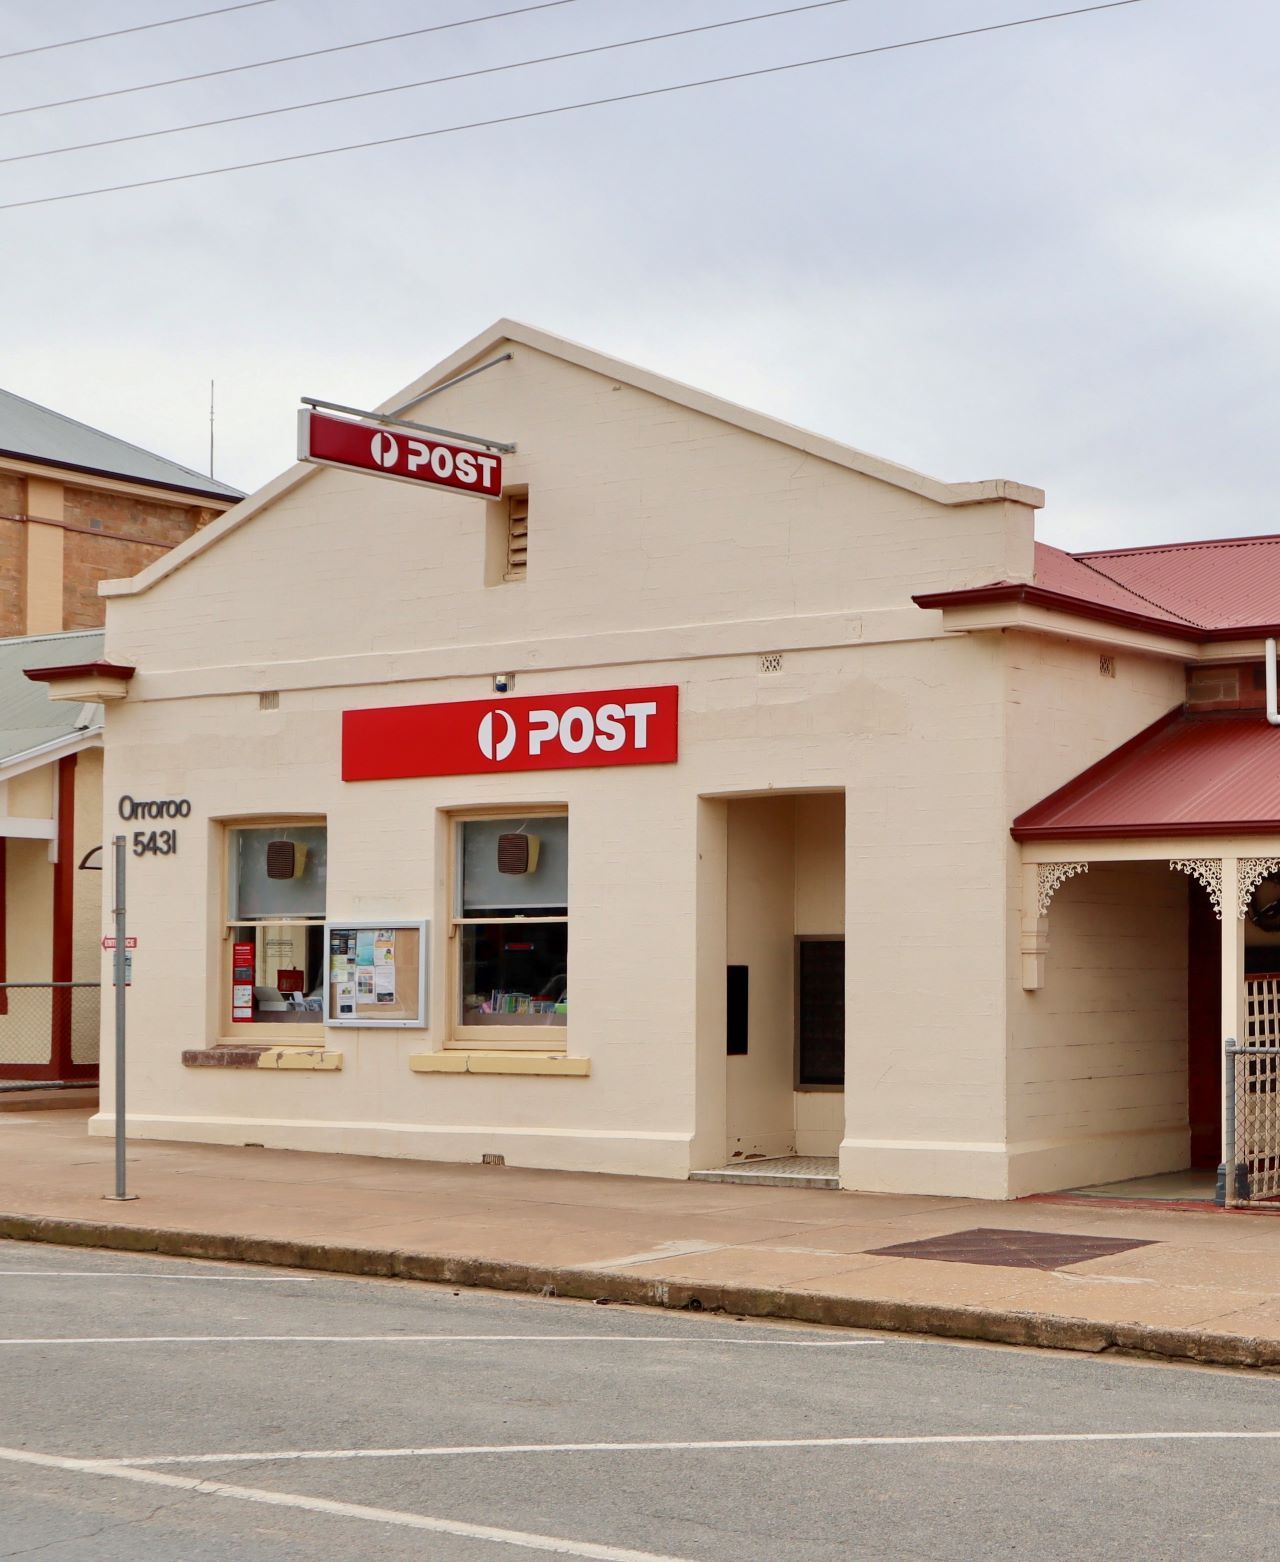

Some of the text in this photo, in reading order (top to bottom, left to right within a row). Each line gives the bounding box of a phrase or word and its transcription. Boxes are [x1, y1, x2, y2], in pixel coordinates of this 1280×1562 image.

[407, 439, 497, 488] POST
[528, 702, 657, 756] POST
[118, 795, 191, 821] Orroroo
[133, 829, 176, 857] 5431
[104, 939, 135, 947] ENTCE
